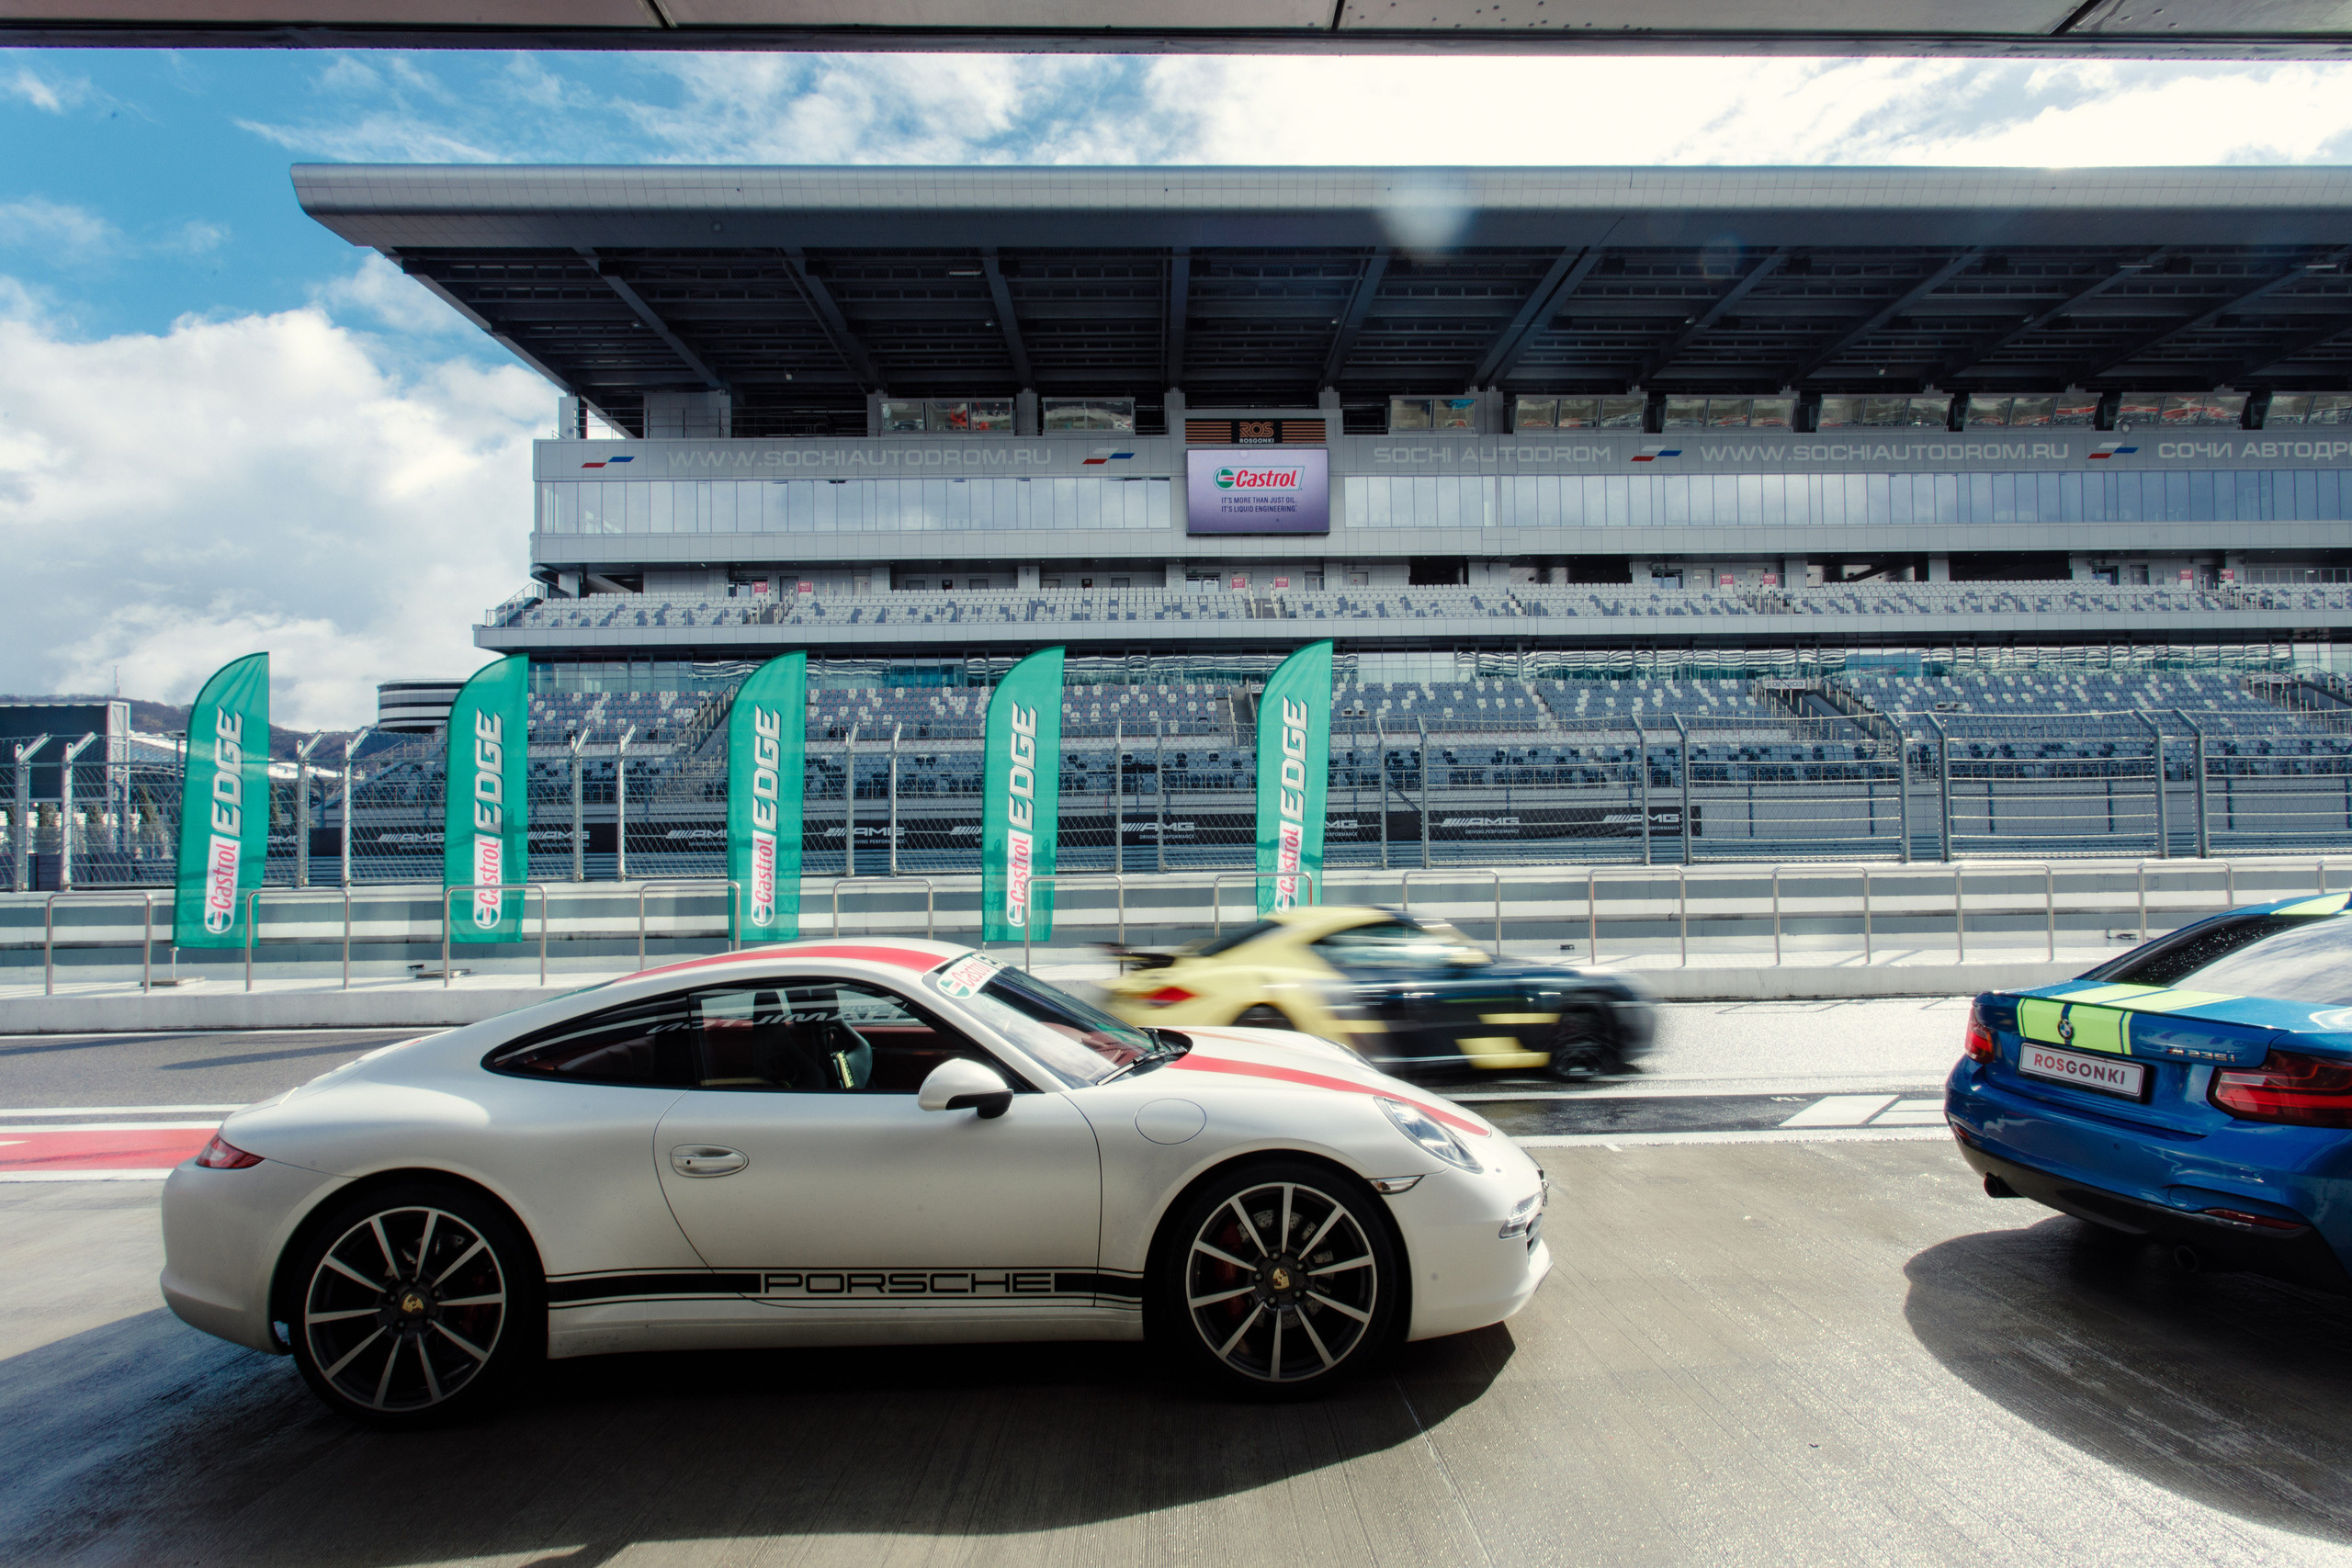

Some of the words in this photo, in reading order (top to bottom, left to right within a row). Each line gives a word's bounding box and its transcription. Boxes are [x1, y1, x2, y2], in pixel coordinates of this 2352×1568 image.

[1239, 422, 1274, 437] ROS
[667, 447, 1052, 468] WWW.SOCHIAUTODROM.RU
[1374, 446, 1452, 463] SOCHI
[1461, 446, 1611, 463] AUTODROM
[1699, 443, 2069, 461] WWW.SOCHIAUTODROM.RU
[2157, 442, 2233, 458] СОЧИ
[2240, 441, 2352, 460] АВТОДР
[1236, 469, 1297, 488] Castrol
[752, 704, 781, 832] EDGE
[1008, 700, 1037, 831] EDGE
[1280, 694, 1308, 822] EDGE
[211, 705, 243, 837] EDGE
[474, 707, 503, 835] EDGE
[1139, 822, 1194, 831] AMG
[1467, 817, 1520, 827] AMG
[1626, 814, 1679, 823] AMG
[210, 842, 236, 909] Castrol
[754, 838, 774, 904] Castrol
[2033, 1053, 2126, 1086] ROSGONKI
[763, 1272, 1052, 1294] PORSCHE
